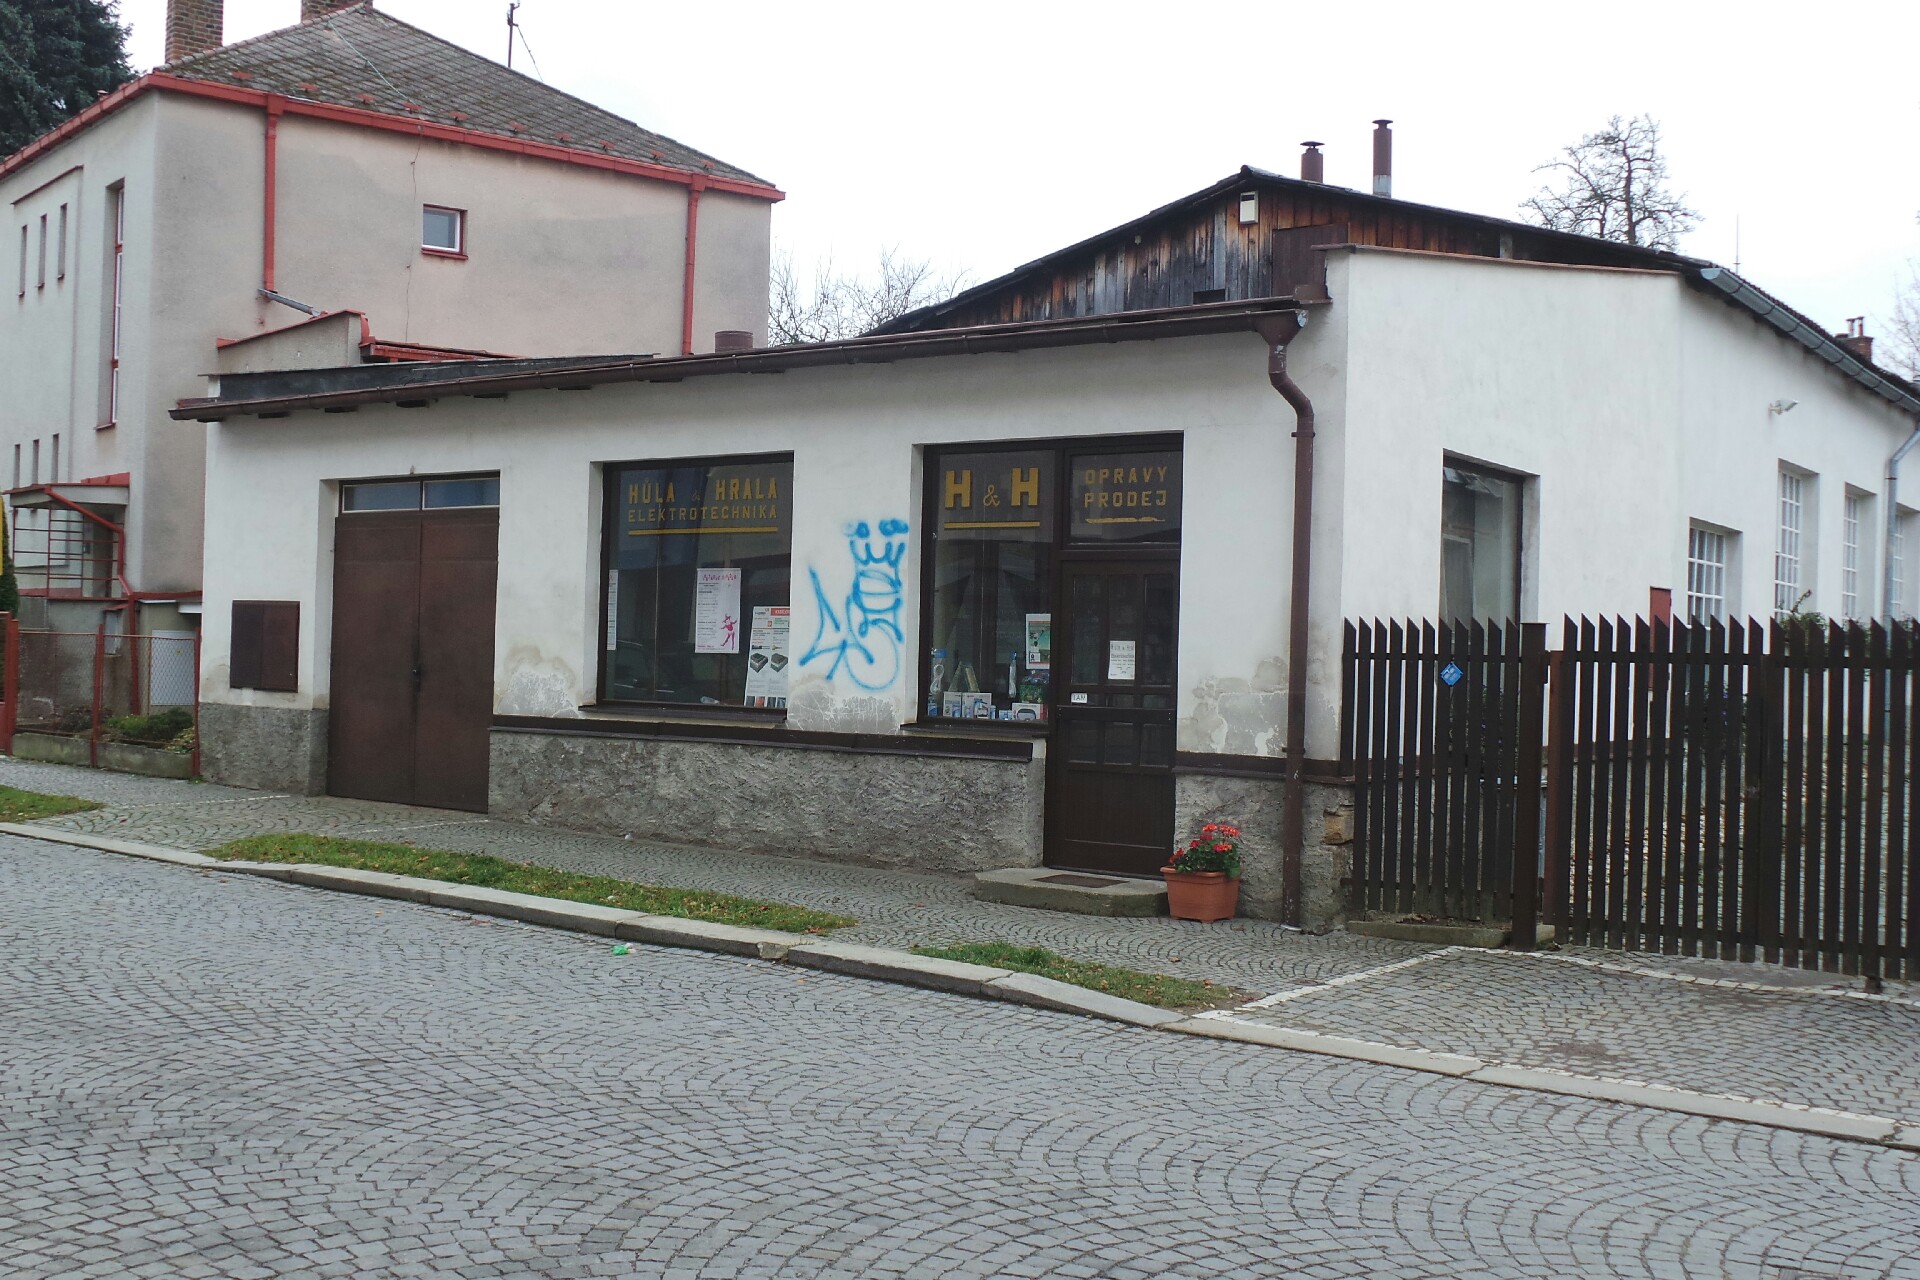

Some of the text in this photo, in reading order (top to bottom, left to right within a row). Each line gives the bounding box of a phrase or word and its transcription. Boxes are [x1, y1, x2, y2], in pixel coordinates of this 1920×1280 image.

[1085, 466, 1167, 485] OPRAVY
[715, 477, 778, 501] HRALA
[945, 467, 1039, 508] H & H
[1084, 490, 1167, 508] PRODEJ
[628, 504, 777, 523] ELEKTROTECHNIKA
